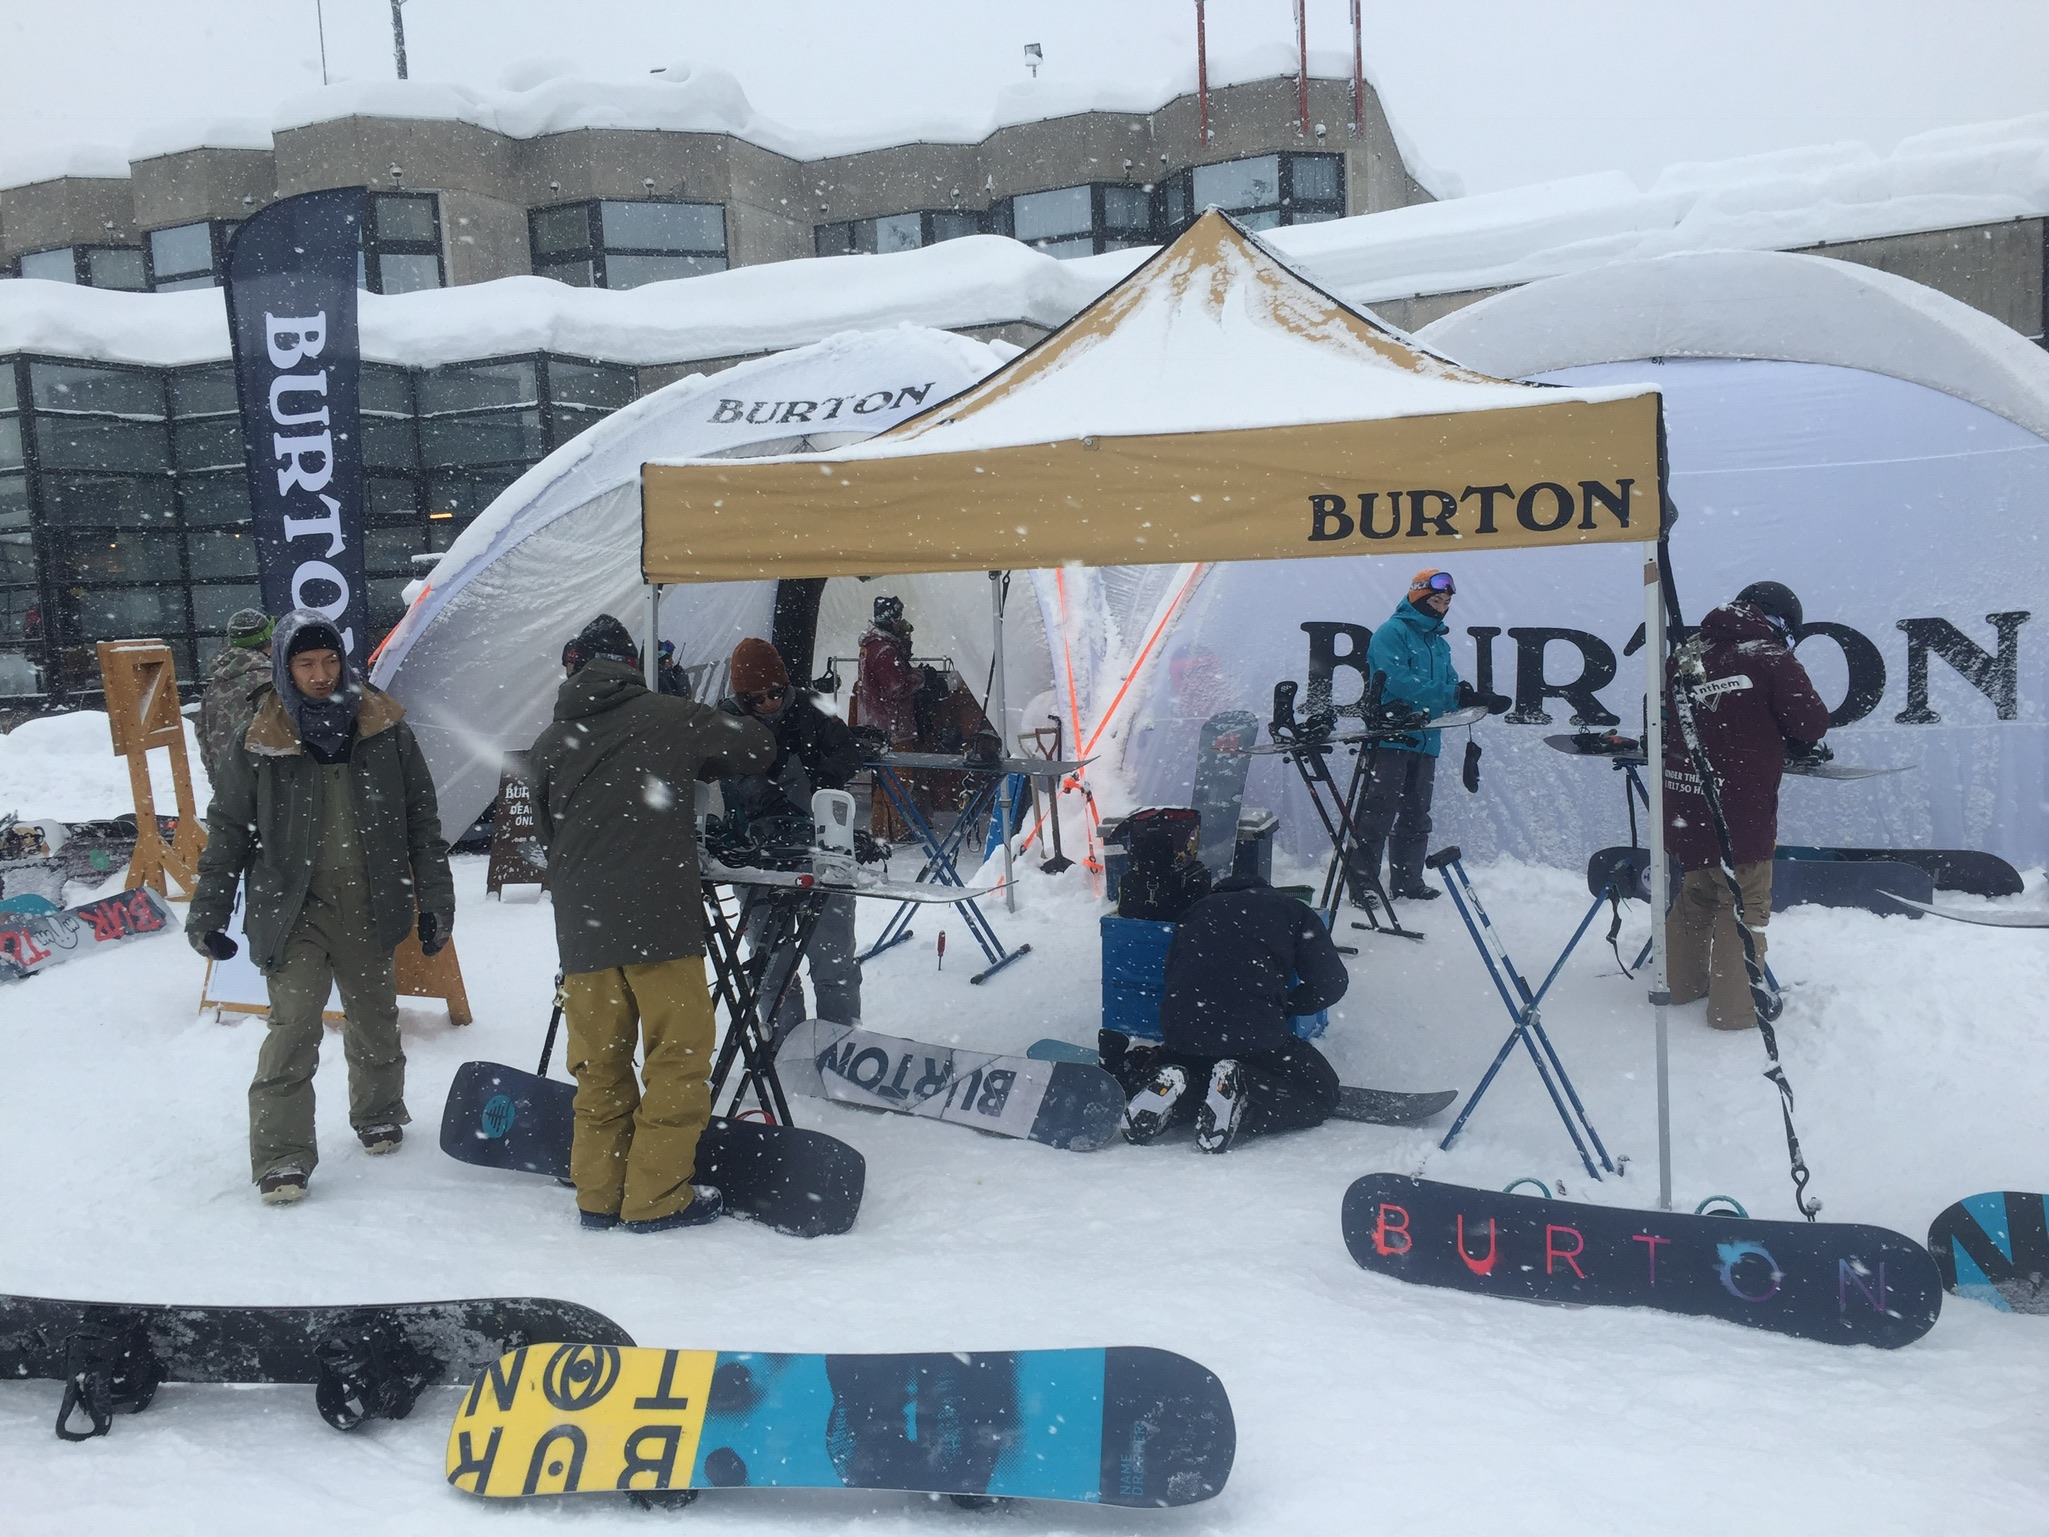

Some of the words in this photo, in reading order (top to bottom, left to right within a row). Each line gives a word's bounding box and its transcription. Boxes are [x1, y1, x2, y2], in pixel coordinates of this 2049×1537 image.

[707, 382, 936, 424] BURTON
[265, 309, 355, 656] BURTO
[1308, 479, 1635, 541] BURTON
[505, 785, 530, 799] BUR
[510, 804, 532, 815] DEA
[515, 816, 534, 826] ONL
[816, 1042, 1017, 1117] BURTON
[1371, 1203, 1886, 1315] BURTON
[1120, 1454, 1132, 1495] NAME
